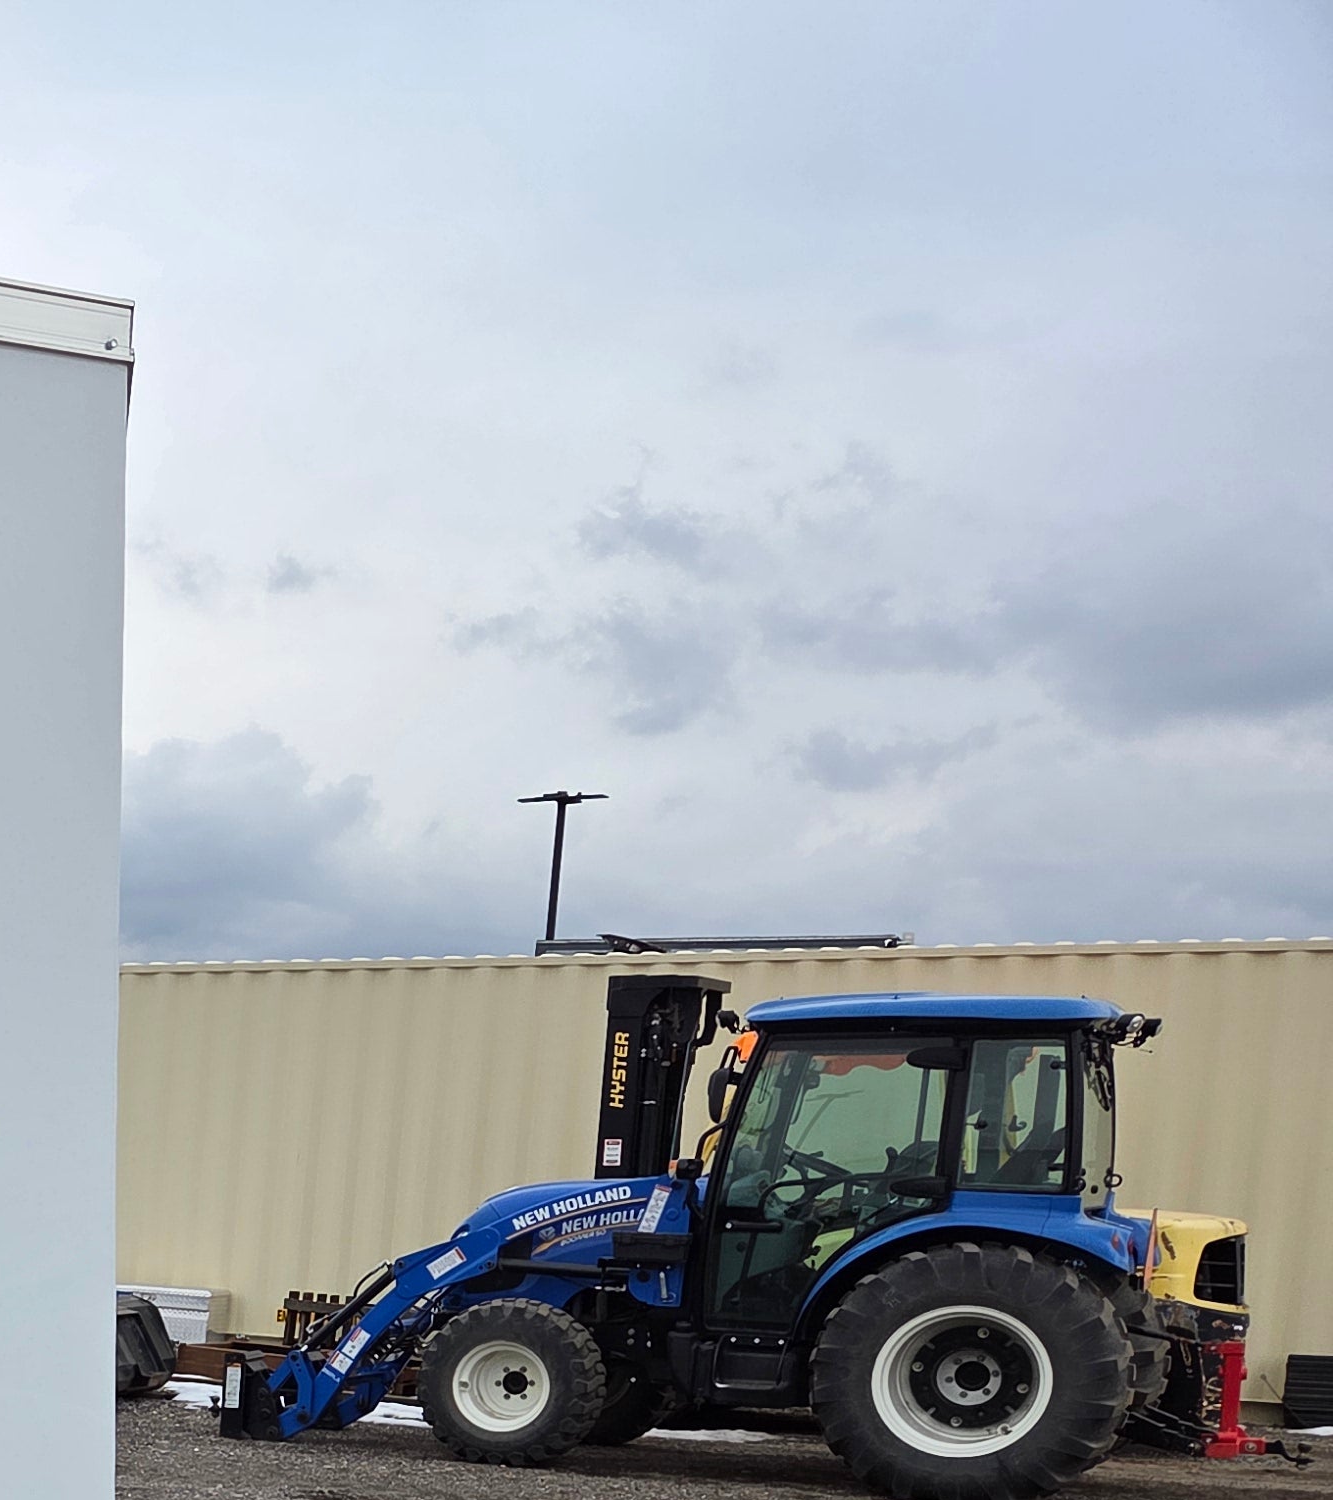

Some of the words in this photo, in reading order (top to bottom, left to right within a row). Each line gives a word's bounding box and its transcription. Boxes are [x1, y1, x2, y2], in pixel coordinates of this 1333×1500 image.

[609, 1032, 629, 1108] HYSTER
[512, 1208, 550, 1230] NEW
[553, 1186, 632, 1216] HOLLAND
[561, 1214, 597, 1235] NEW
